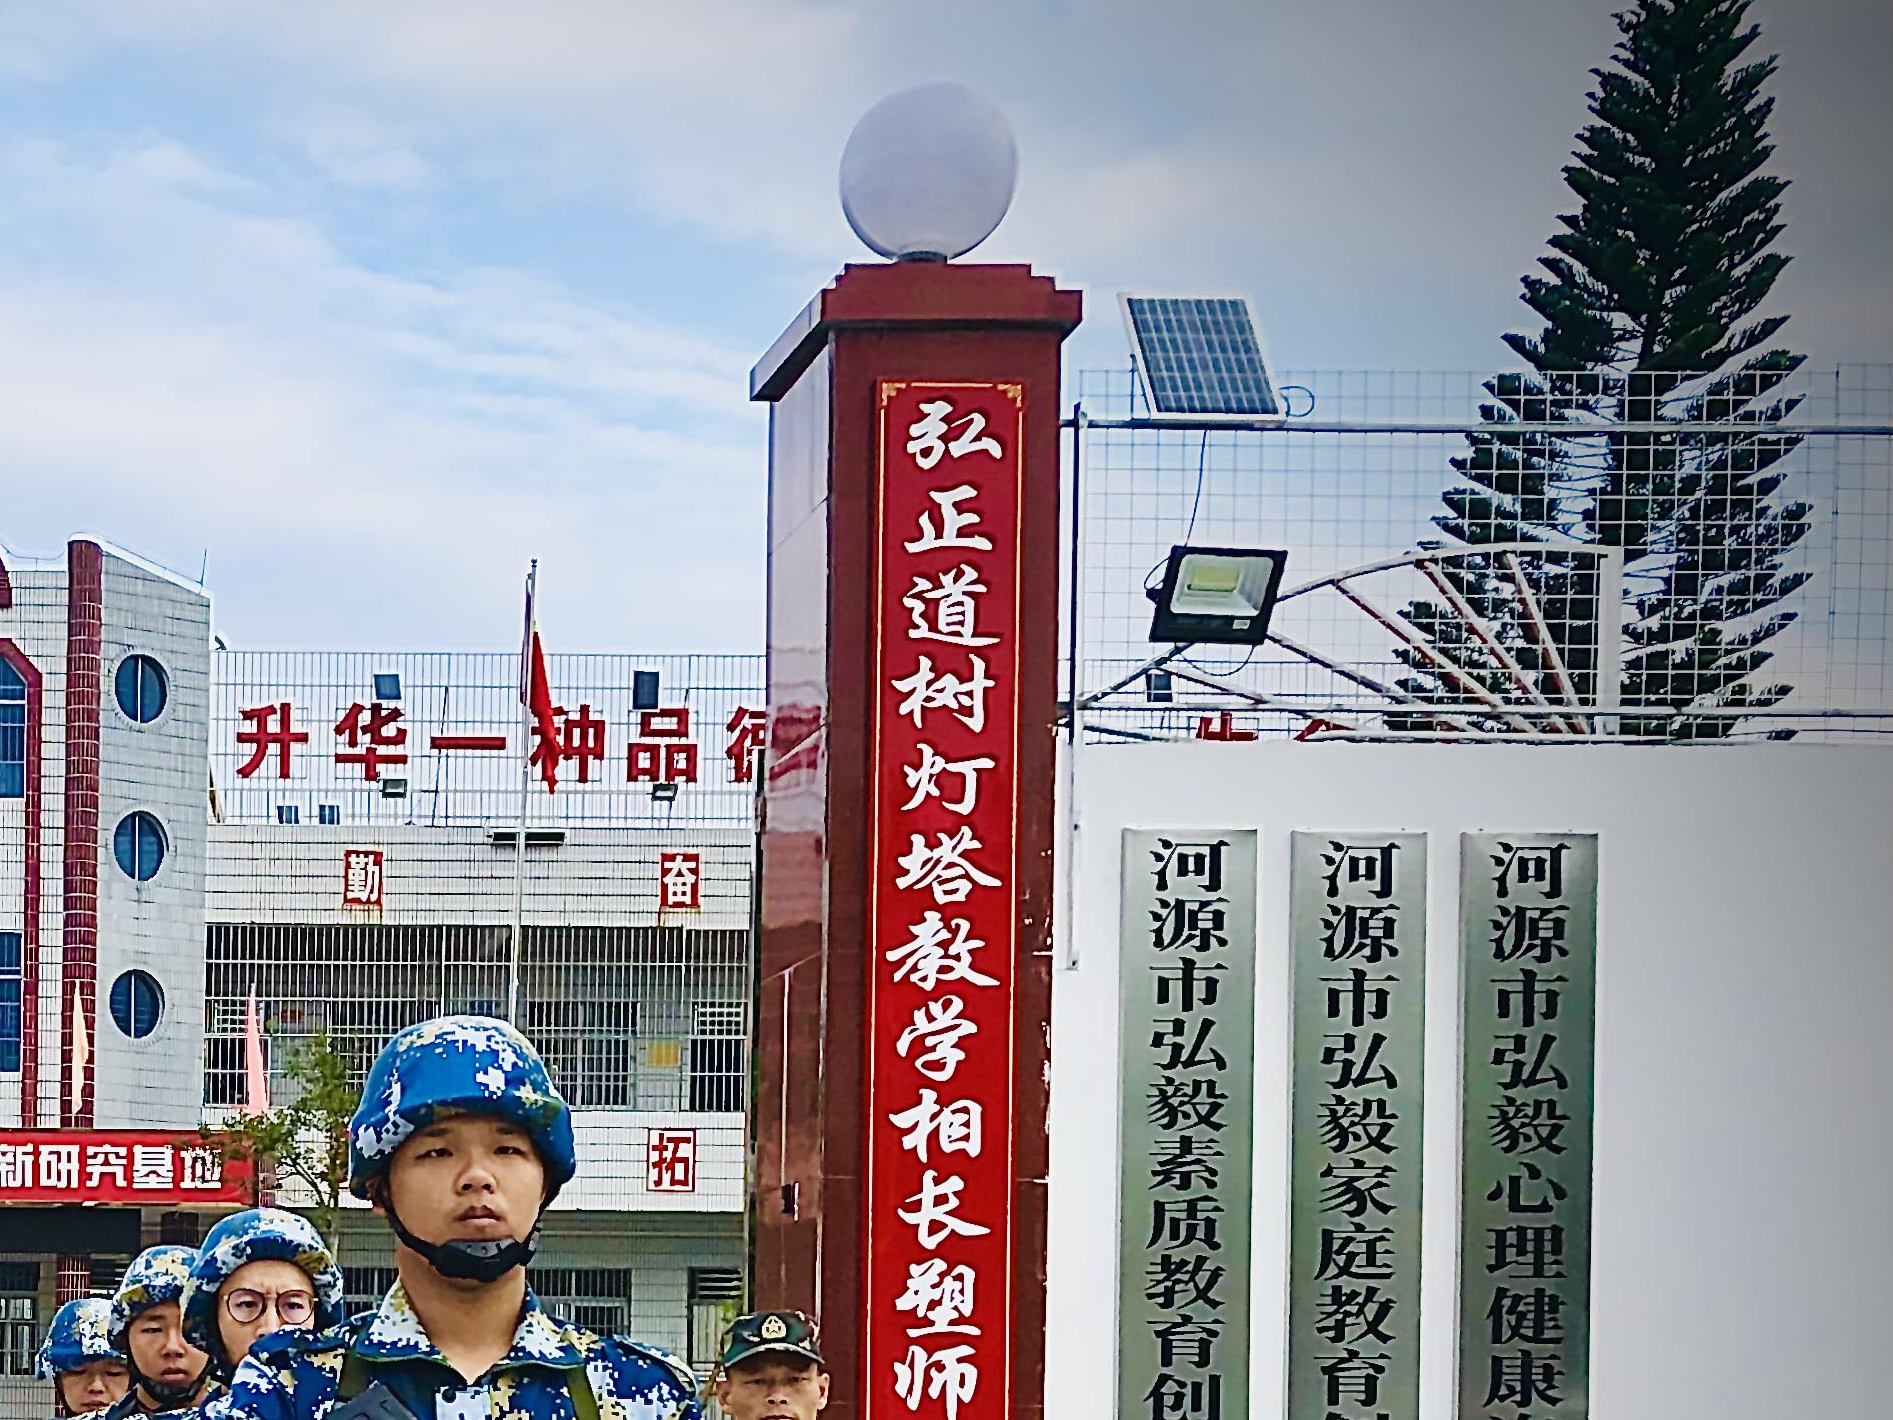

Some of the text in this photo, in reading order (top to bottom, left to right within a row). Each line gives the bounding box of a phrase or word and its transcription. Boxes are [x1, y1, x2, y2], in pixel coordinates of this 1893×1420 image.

[347, 854, 698, 905] 勤 奋
[652, 1134, 692, 1188] 拓
